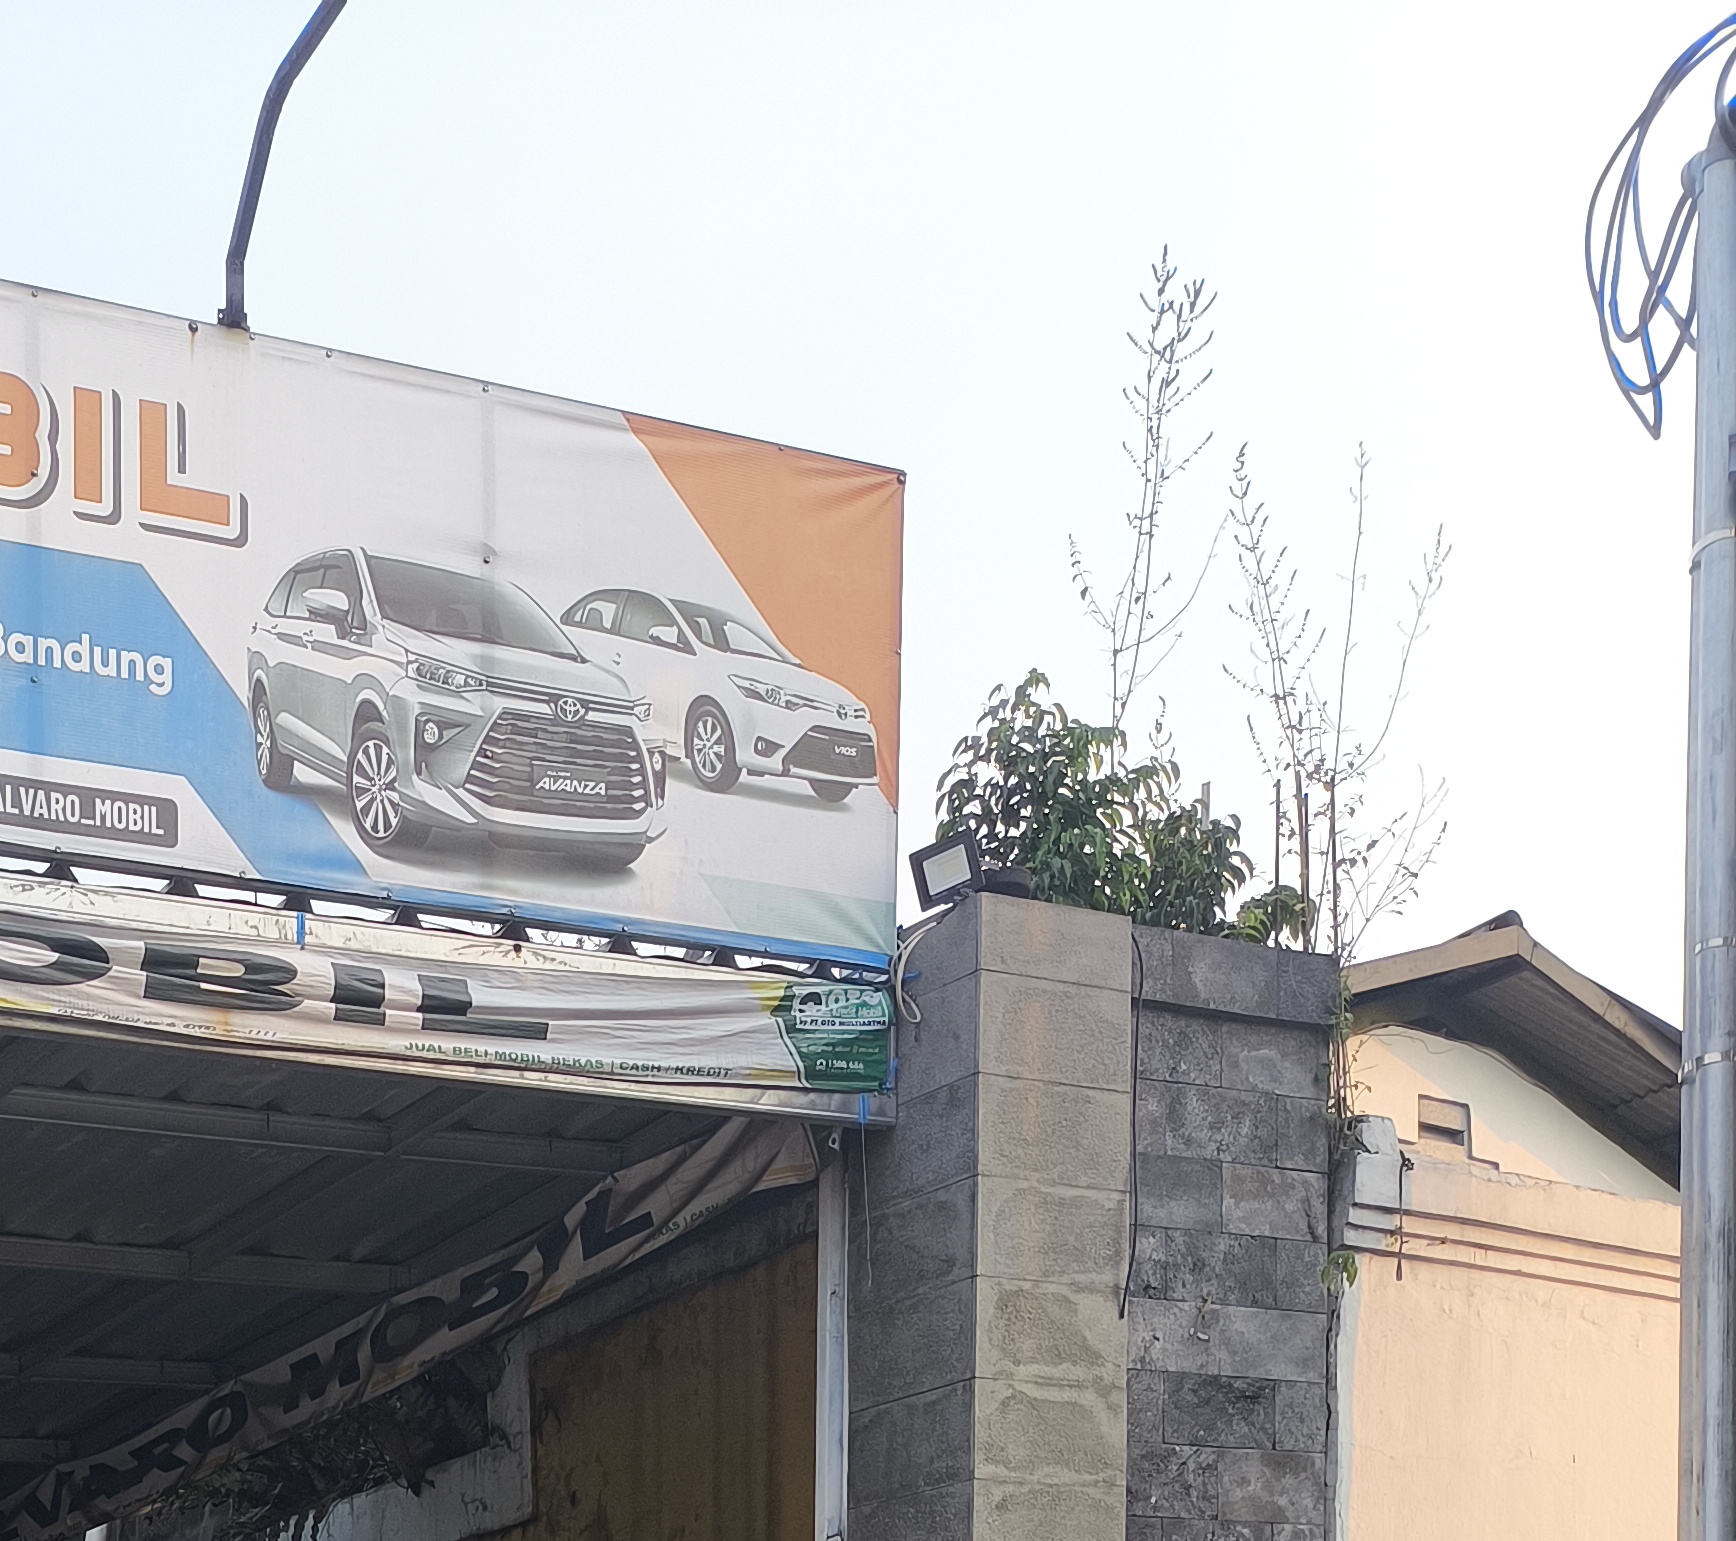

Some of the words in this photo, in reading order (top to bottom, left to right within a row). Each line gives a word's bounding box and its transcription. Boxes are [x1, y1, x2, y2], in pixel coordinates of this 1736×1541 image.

[834, 745, 857, 757] VIOS
[535, 777, 606, 796] AVANZA
[404, 1042, 446, 1054] JUAL
[452, 1046, 488, 1058] BELI
[494, 1050, 546, 1064] MOBIL
[551, 1056, 604, 1069] BEKAS
[619, 1061, 662, 1073] CASH
[674, 1065, 733, 1078] KREDIT
